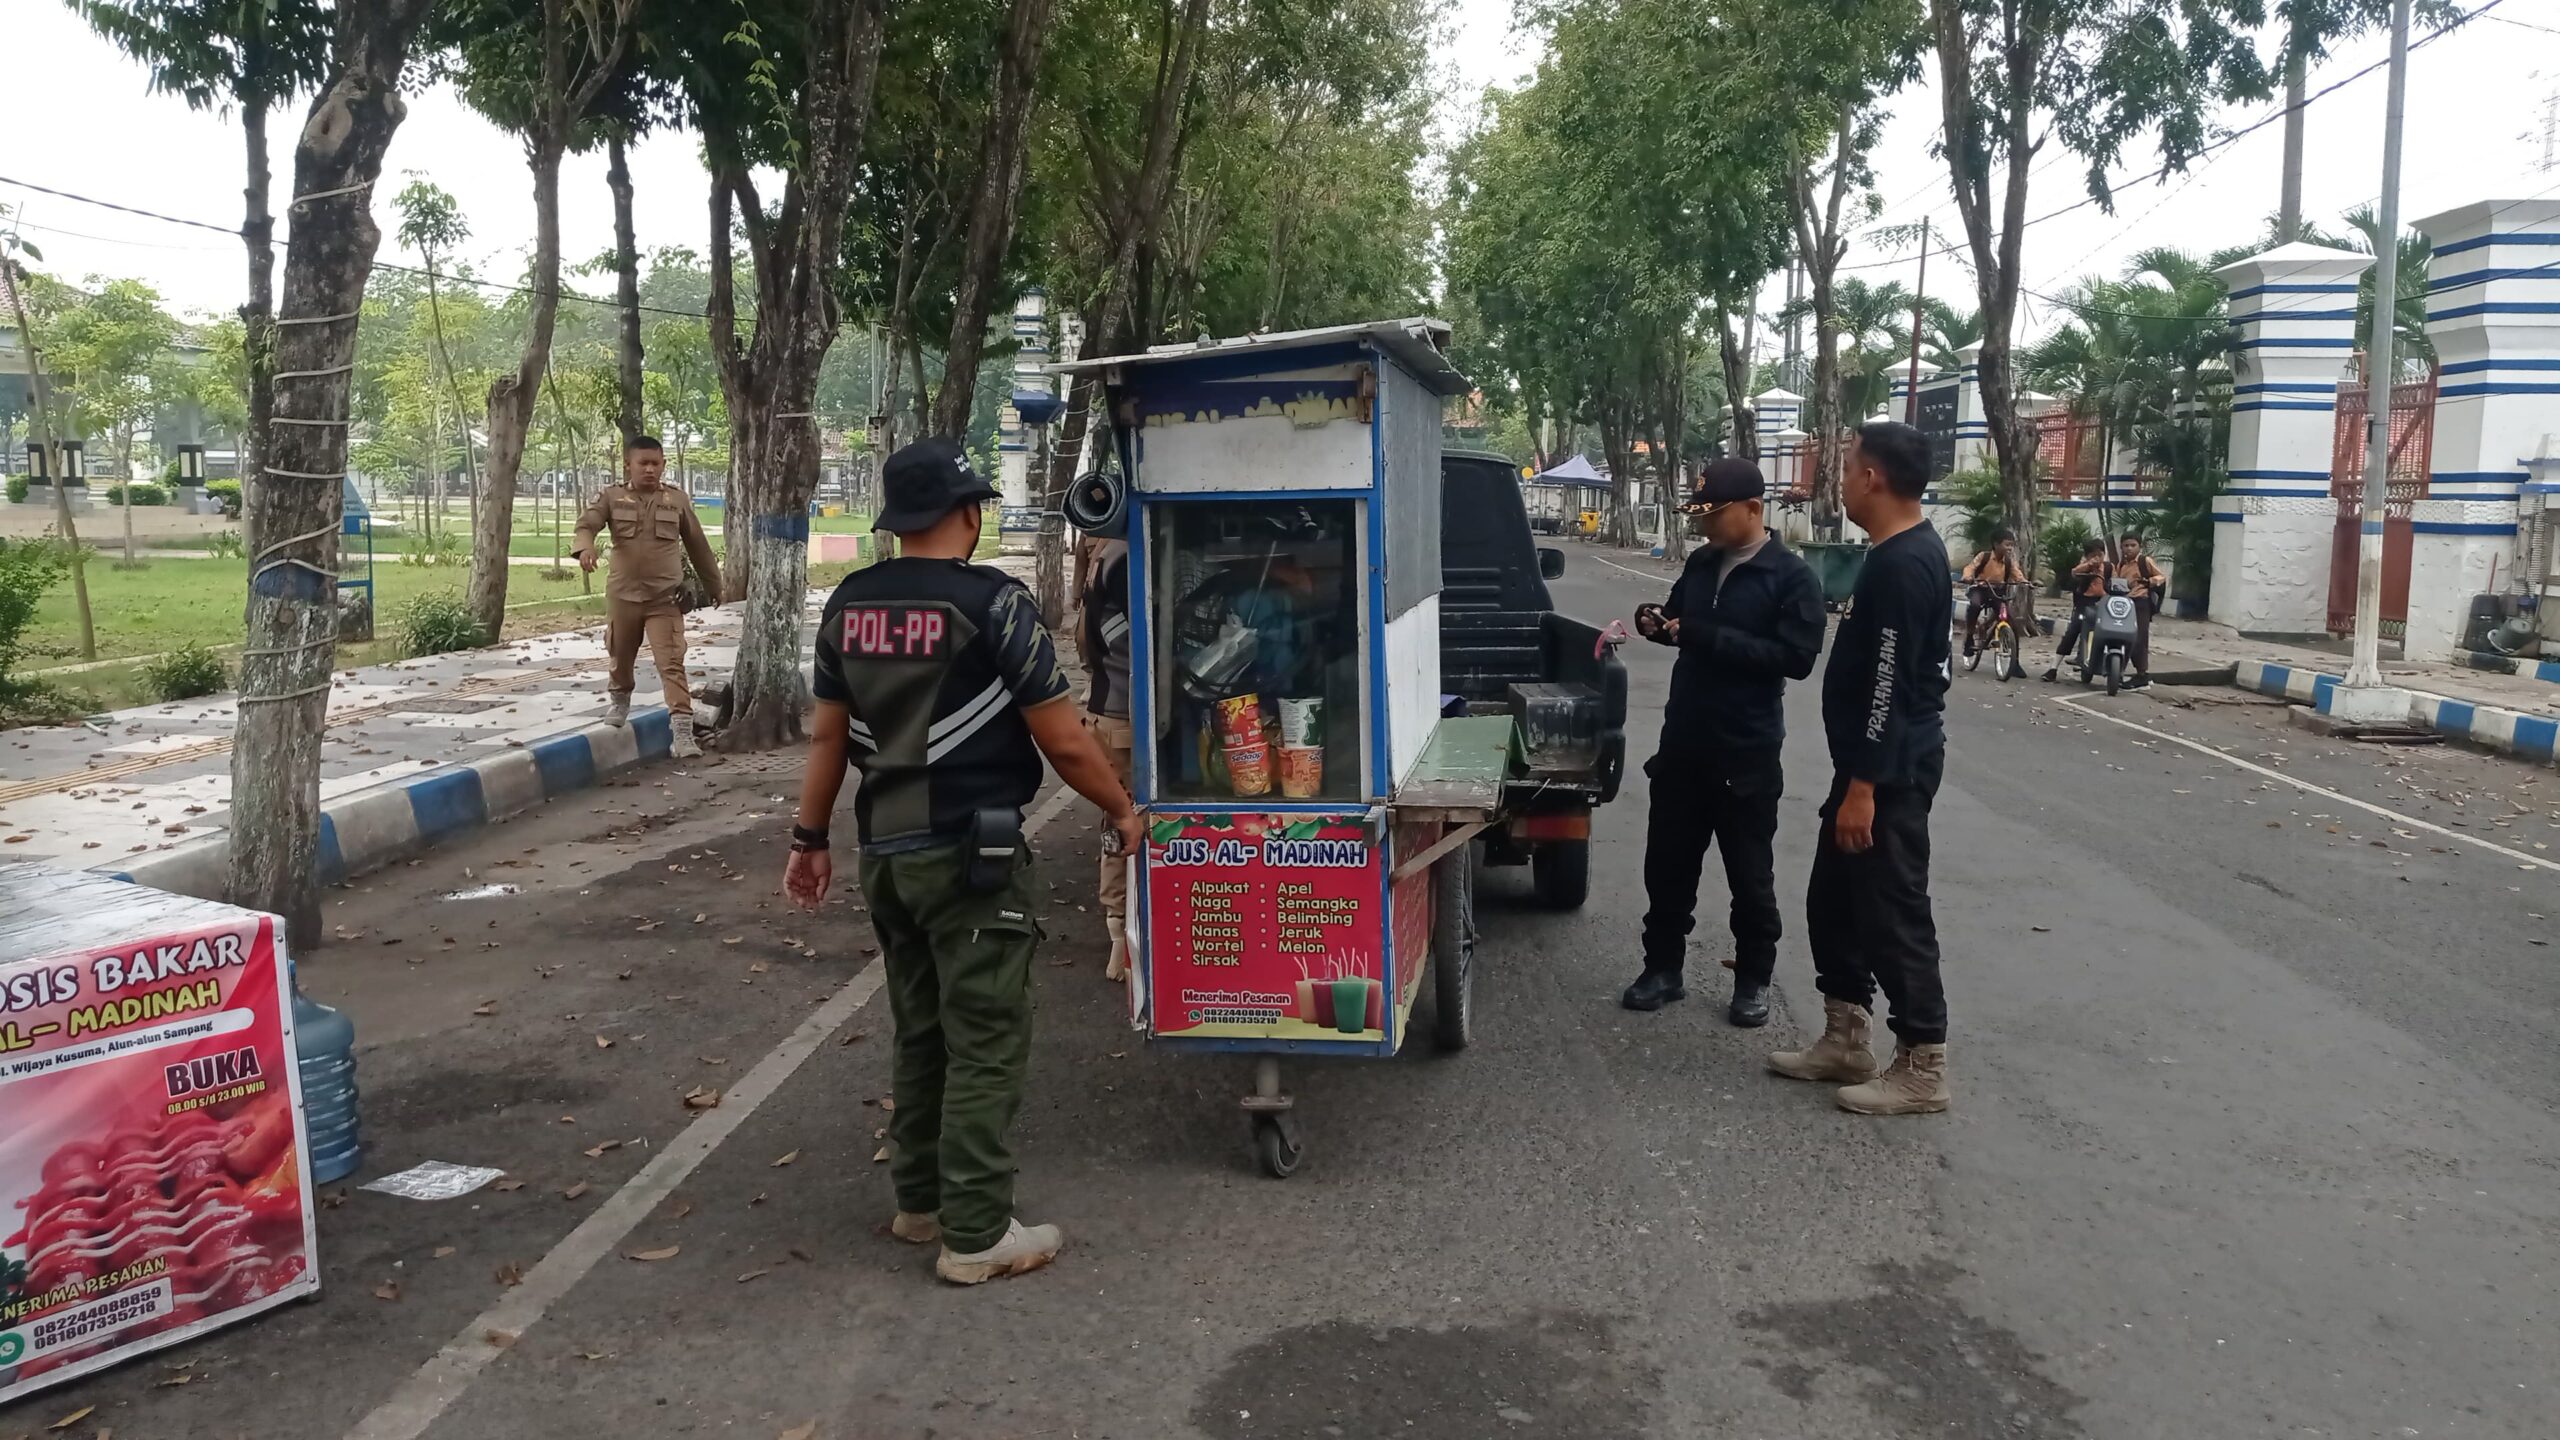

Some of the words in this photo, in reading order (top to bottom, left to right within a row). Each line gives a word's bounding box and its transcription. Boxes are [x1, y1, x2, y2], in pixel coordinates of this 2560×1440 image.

[842, 610, 944, 655] POL-PP
[1231, 751, 1264, 762] Sedaap
[1164, 839, 1208, 866] JUS
[1213, 840, 1257, 866] AL-
[1262, 840, 1367, 868] MADINAH
[1190, 880, 1250, 896] Alpukat
[1277, 881, 1312, 897] Apel
[1190, 895, 1231, 911] Naga
[1277, 897, 1359, 913] Semangka
[1191, 909, 1242, 924] Jambu
[1277, 911, 1353, 927] Belimbing
[1191, 924, 1240, 938] Nanas
[1278, 926, 1323, 940] Jeruk
[1191, 938, 1245, 952] Wortel
[1278, 940, 1326, 954] Melon
[92, 933, 246, 993] BAKAR
[1192, 953, 1241, 967] Sirsak
[1182, 989, 1240, 1004] Menerima
[1241, 990, 1292, 1006] Pesanan
[69, 979, 221, 1037] MADINAH
[11, 1058, 53, 1074] Wijaya
[55, 1047, 106, 1064] Kusuma,
[108, 1032, 162, 1053] Alun-alun
[163, 1020, 214, 1040] Sampang
[165, 1046, 262, 1098] BUKA
[168, 1098, 198, 1115] 08.00
[217, 1086, 246, 1102] 23.00
[245, 1080, 266, 1094] WIB
[85, 1256, 166, 1295] PESANAN
[33, 1287, 162, 1338] 082244088859
[34, 1301, 156, 1349] 081807335218
